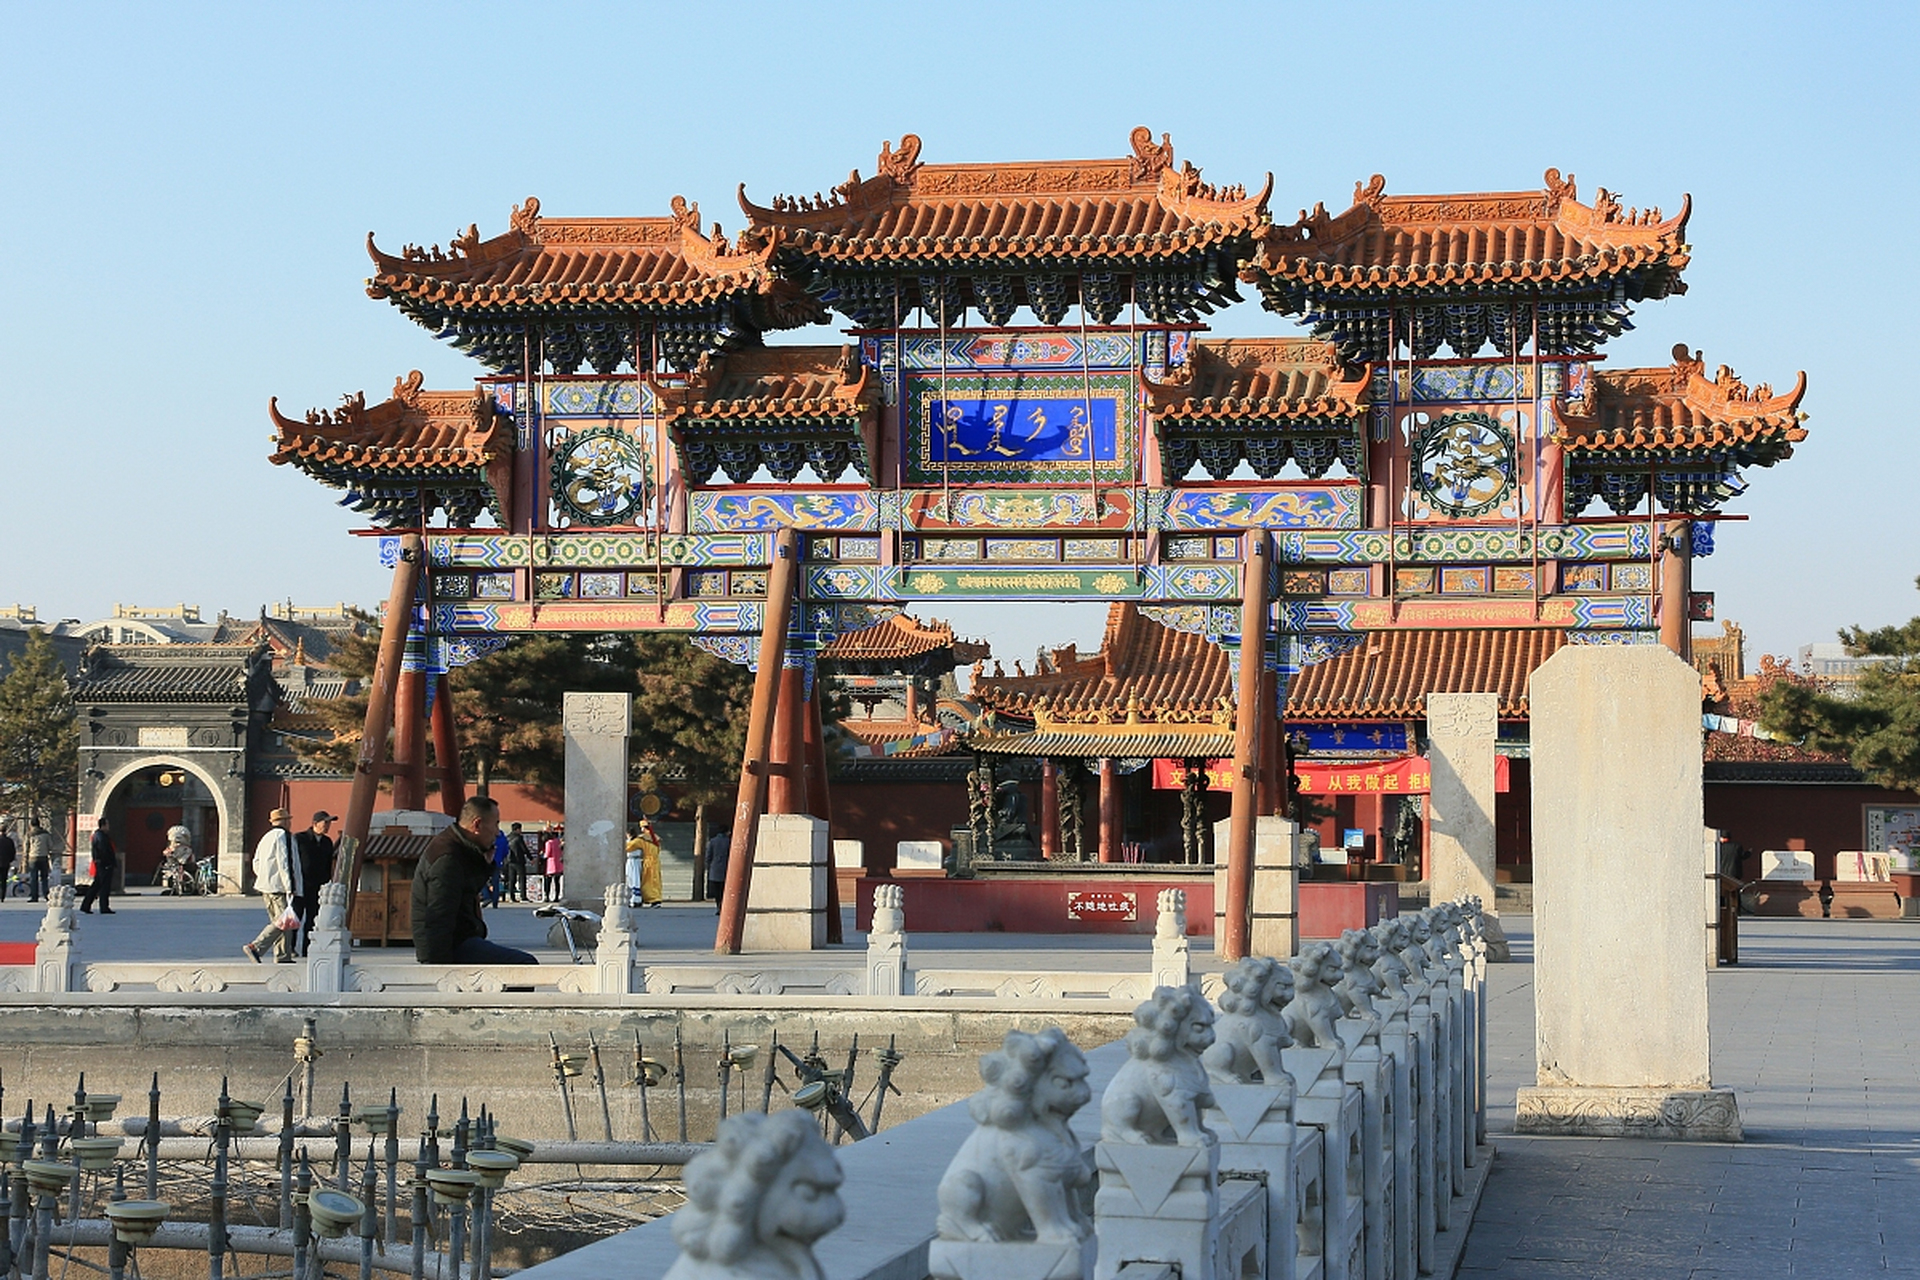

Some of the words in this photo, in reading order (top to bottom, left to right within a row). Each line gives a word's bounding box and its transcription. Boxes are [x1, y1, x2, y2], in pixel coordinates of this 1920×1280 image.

[1170, 770, 1234, 788] 文敬香
[1328, 774, 1399, 791] 从我做起
